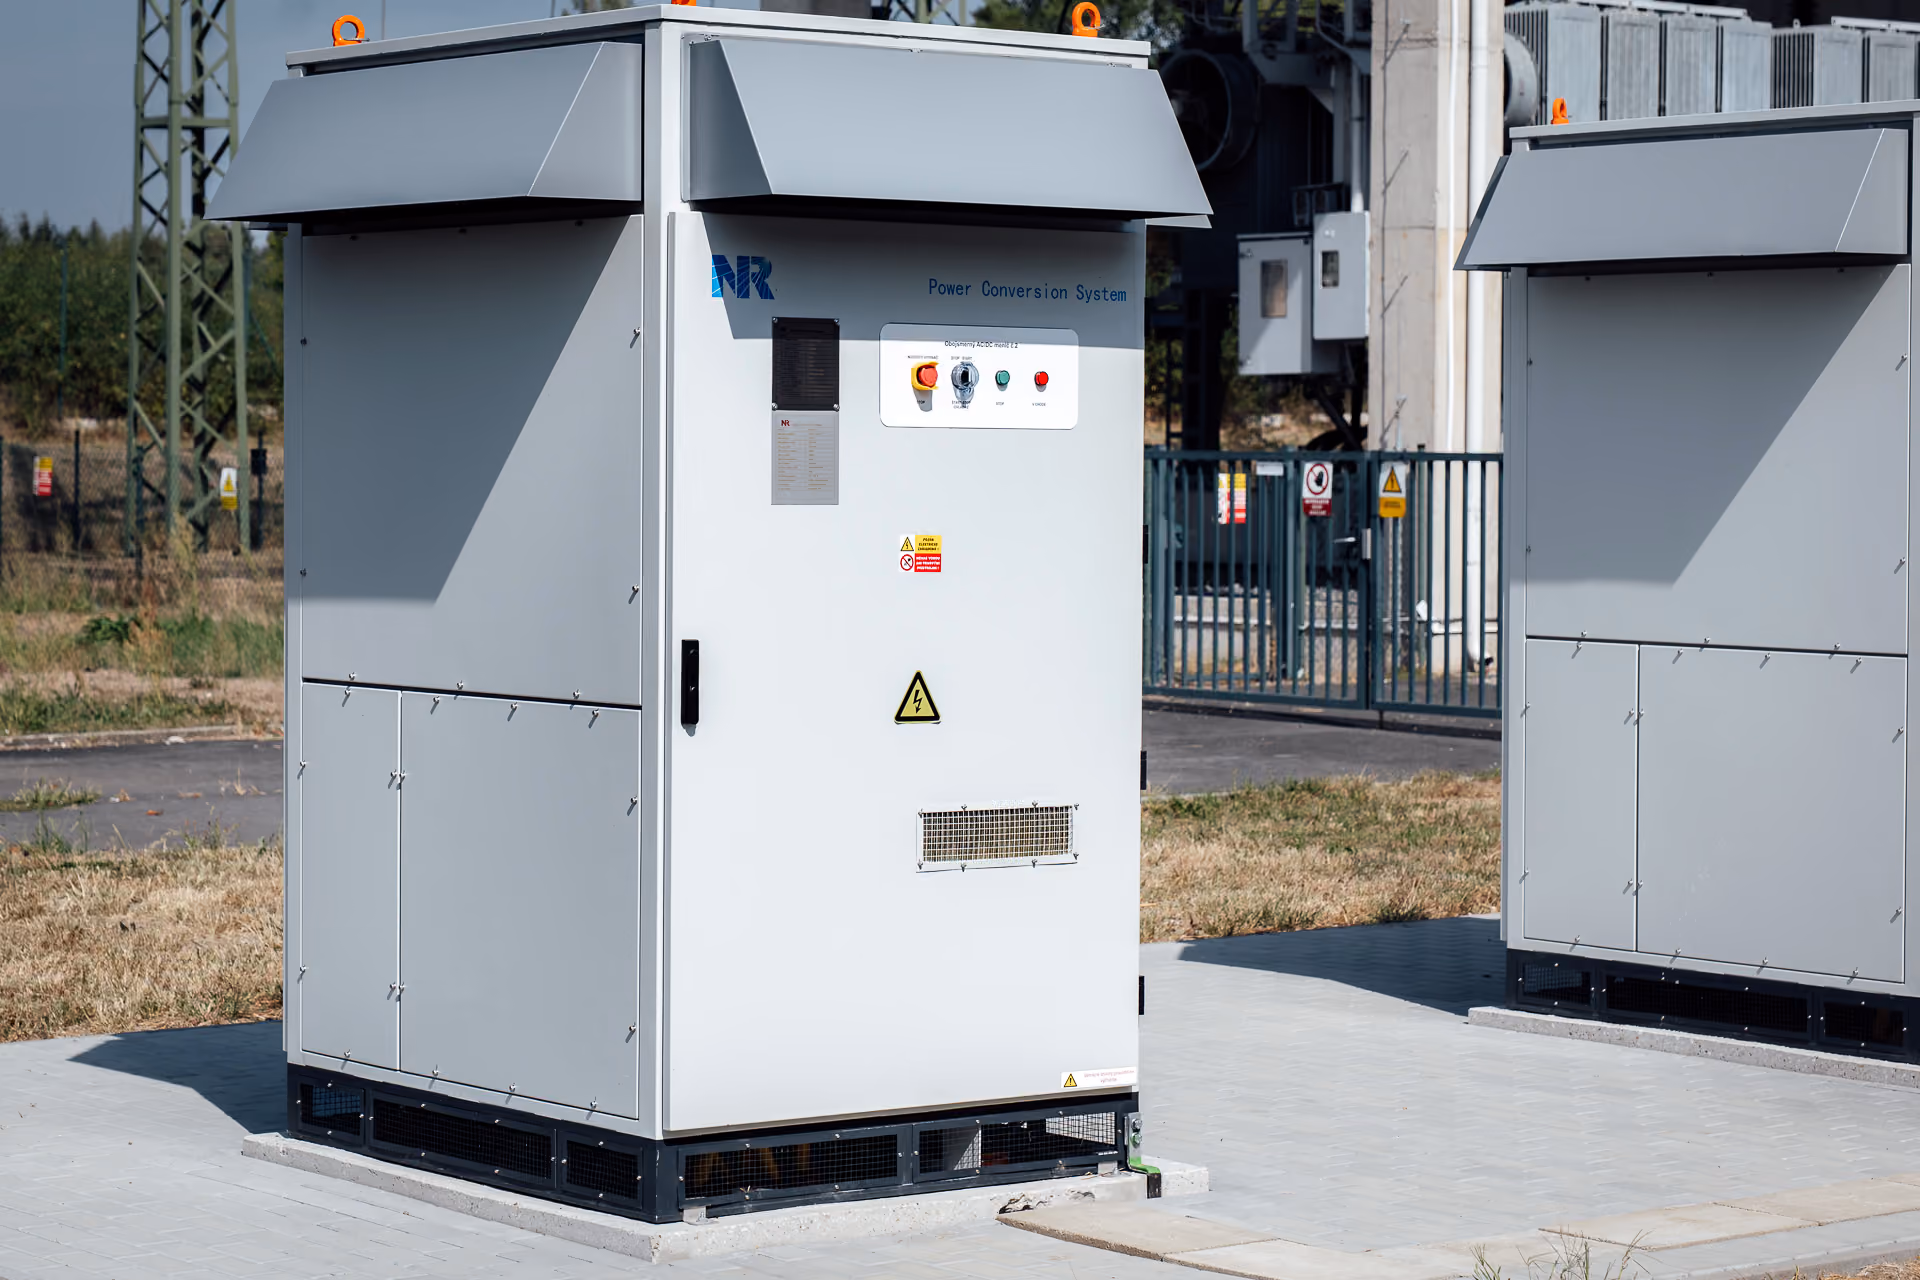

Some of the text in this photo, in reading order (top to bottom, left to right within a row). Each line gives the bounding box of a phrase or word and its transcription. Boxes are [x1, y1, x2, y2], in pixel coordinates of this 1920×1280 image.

[712, 255, 775, 300] NR
[928, 278, 1127, 304] Power Conversion System
